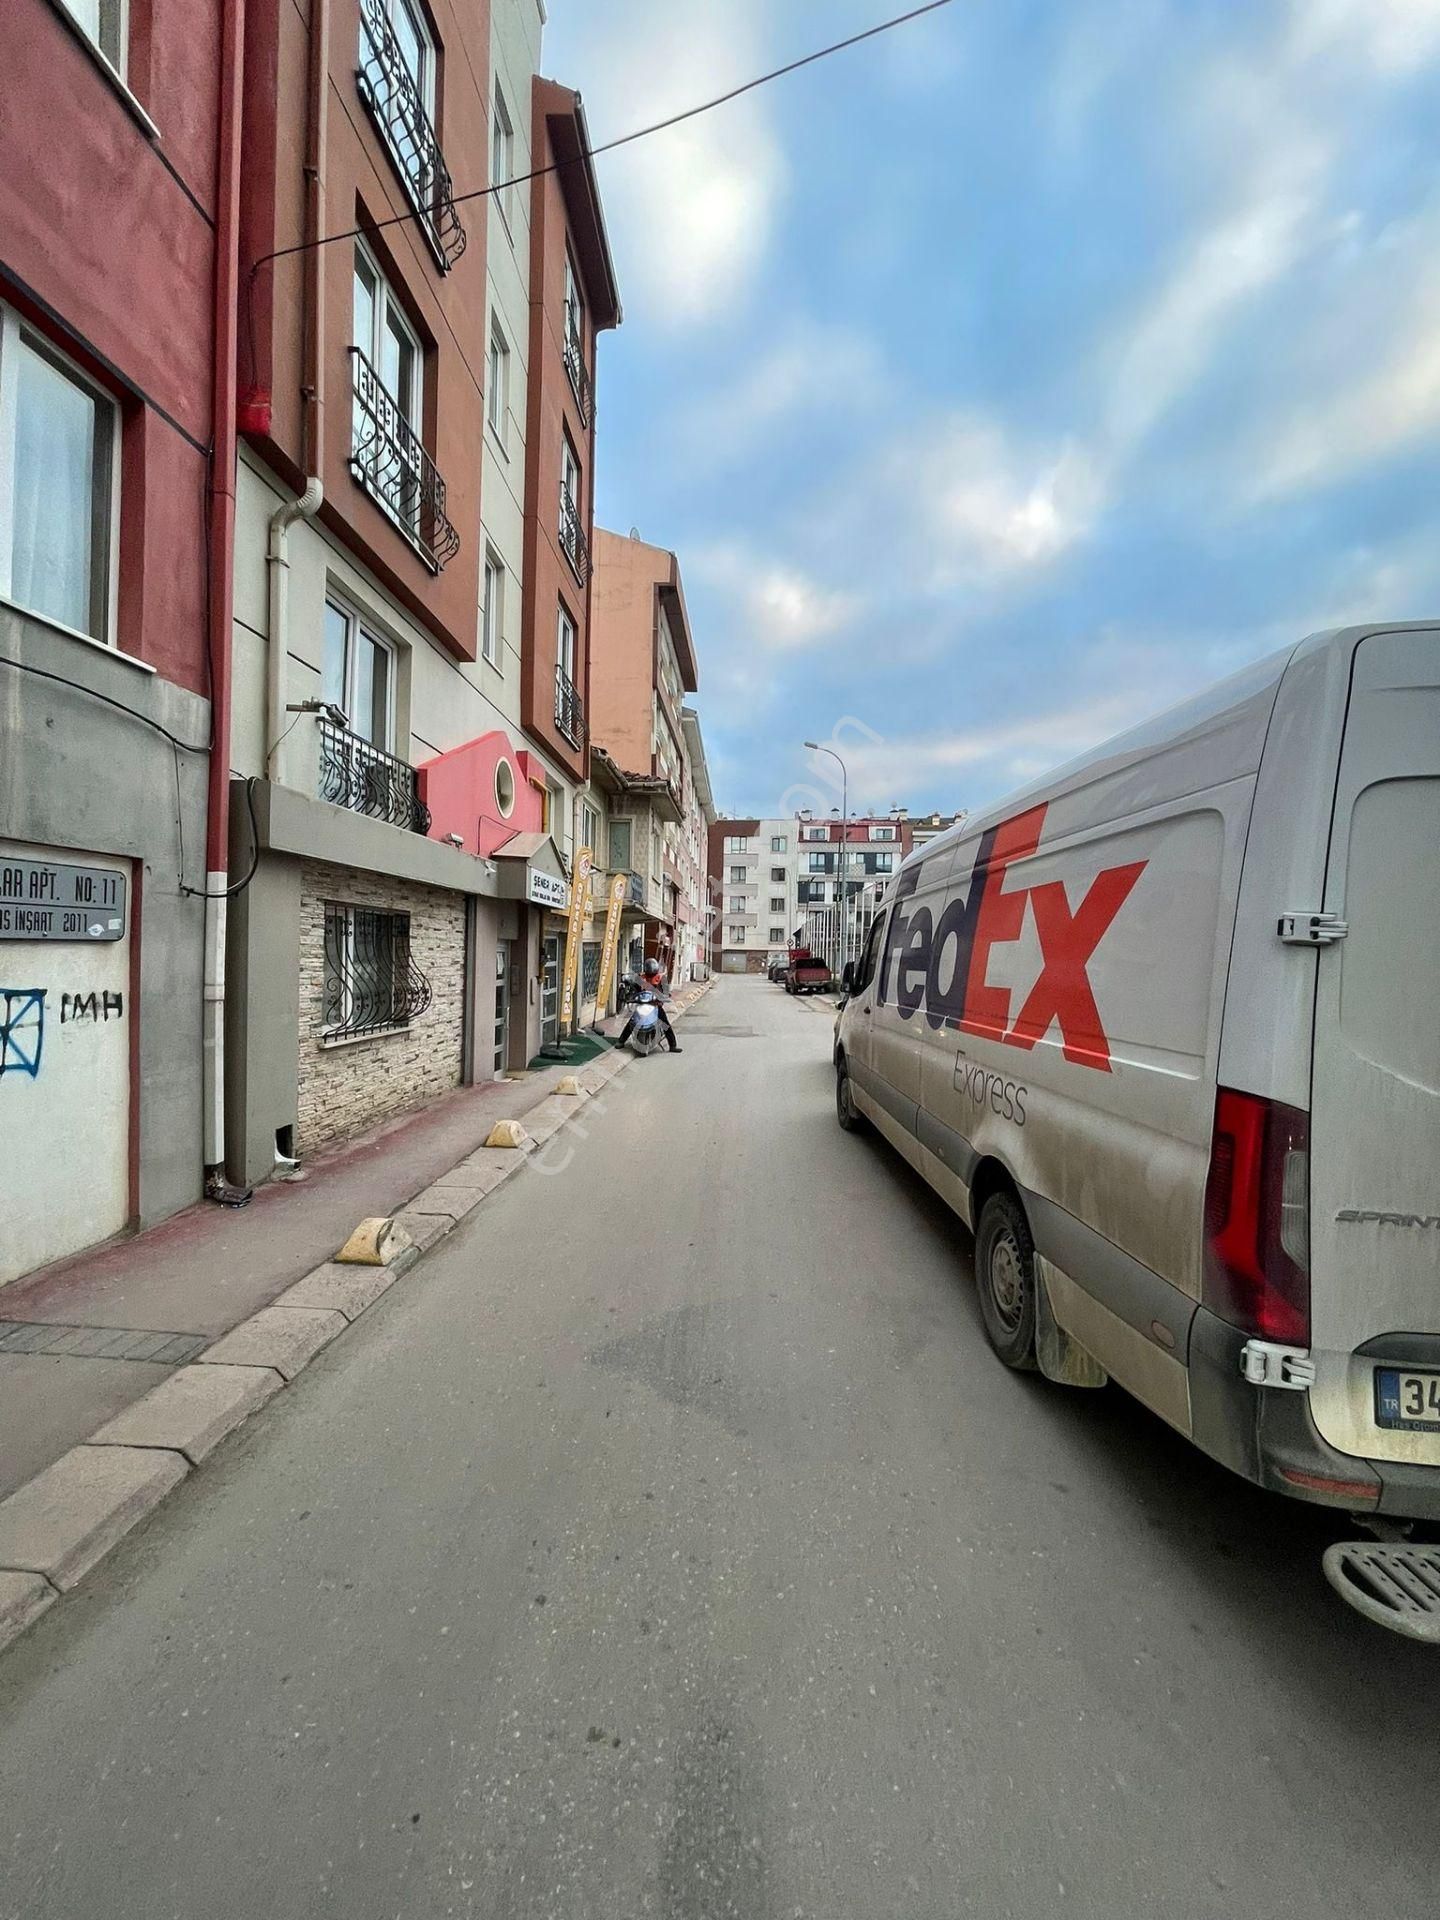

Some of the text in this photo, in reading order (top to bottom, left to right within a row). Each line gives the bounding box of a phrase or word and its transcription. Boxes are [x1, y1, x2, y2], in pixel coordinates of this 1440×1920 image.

[0, 867, 23, 898] AR
[103, 878, 116, 905] 11
[15, 906, 54, 934] İNŞAAT
[63, 912, 88, 933] 2011
[876, 800, 1150, 1074] FedEx
[953, 1049, 1028, 1127] Express
[1383, 1378, 1440, 1416] TR 34
